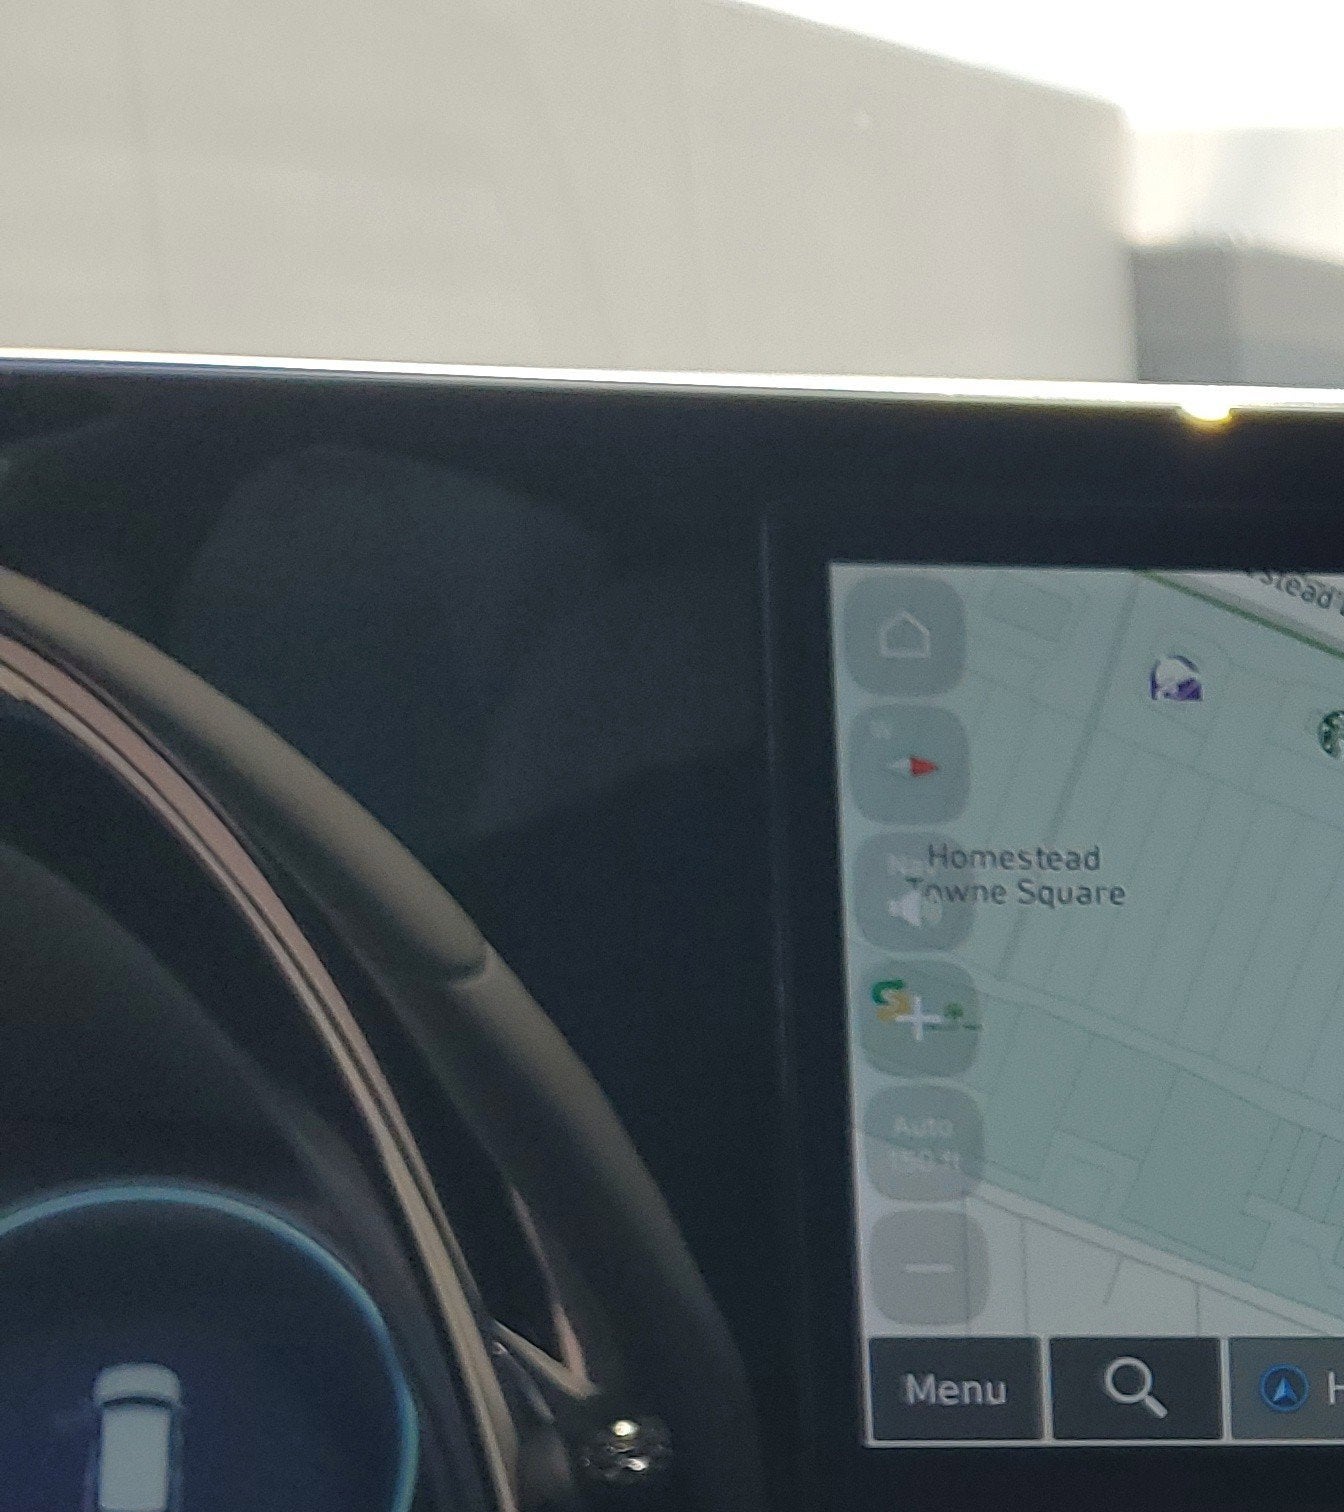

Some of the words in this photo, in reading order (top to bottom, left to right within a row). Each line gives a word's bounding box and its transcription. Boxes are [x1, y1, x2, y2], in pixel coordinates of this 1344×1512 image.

[1249, 568, 1336, 610] stead
[927, 843, 1101, 872] Homestead
[1017, 877, 1126, 909] Square
[904, 1372, 1008, 1407] Menu
